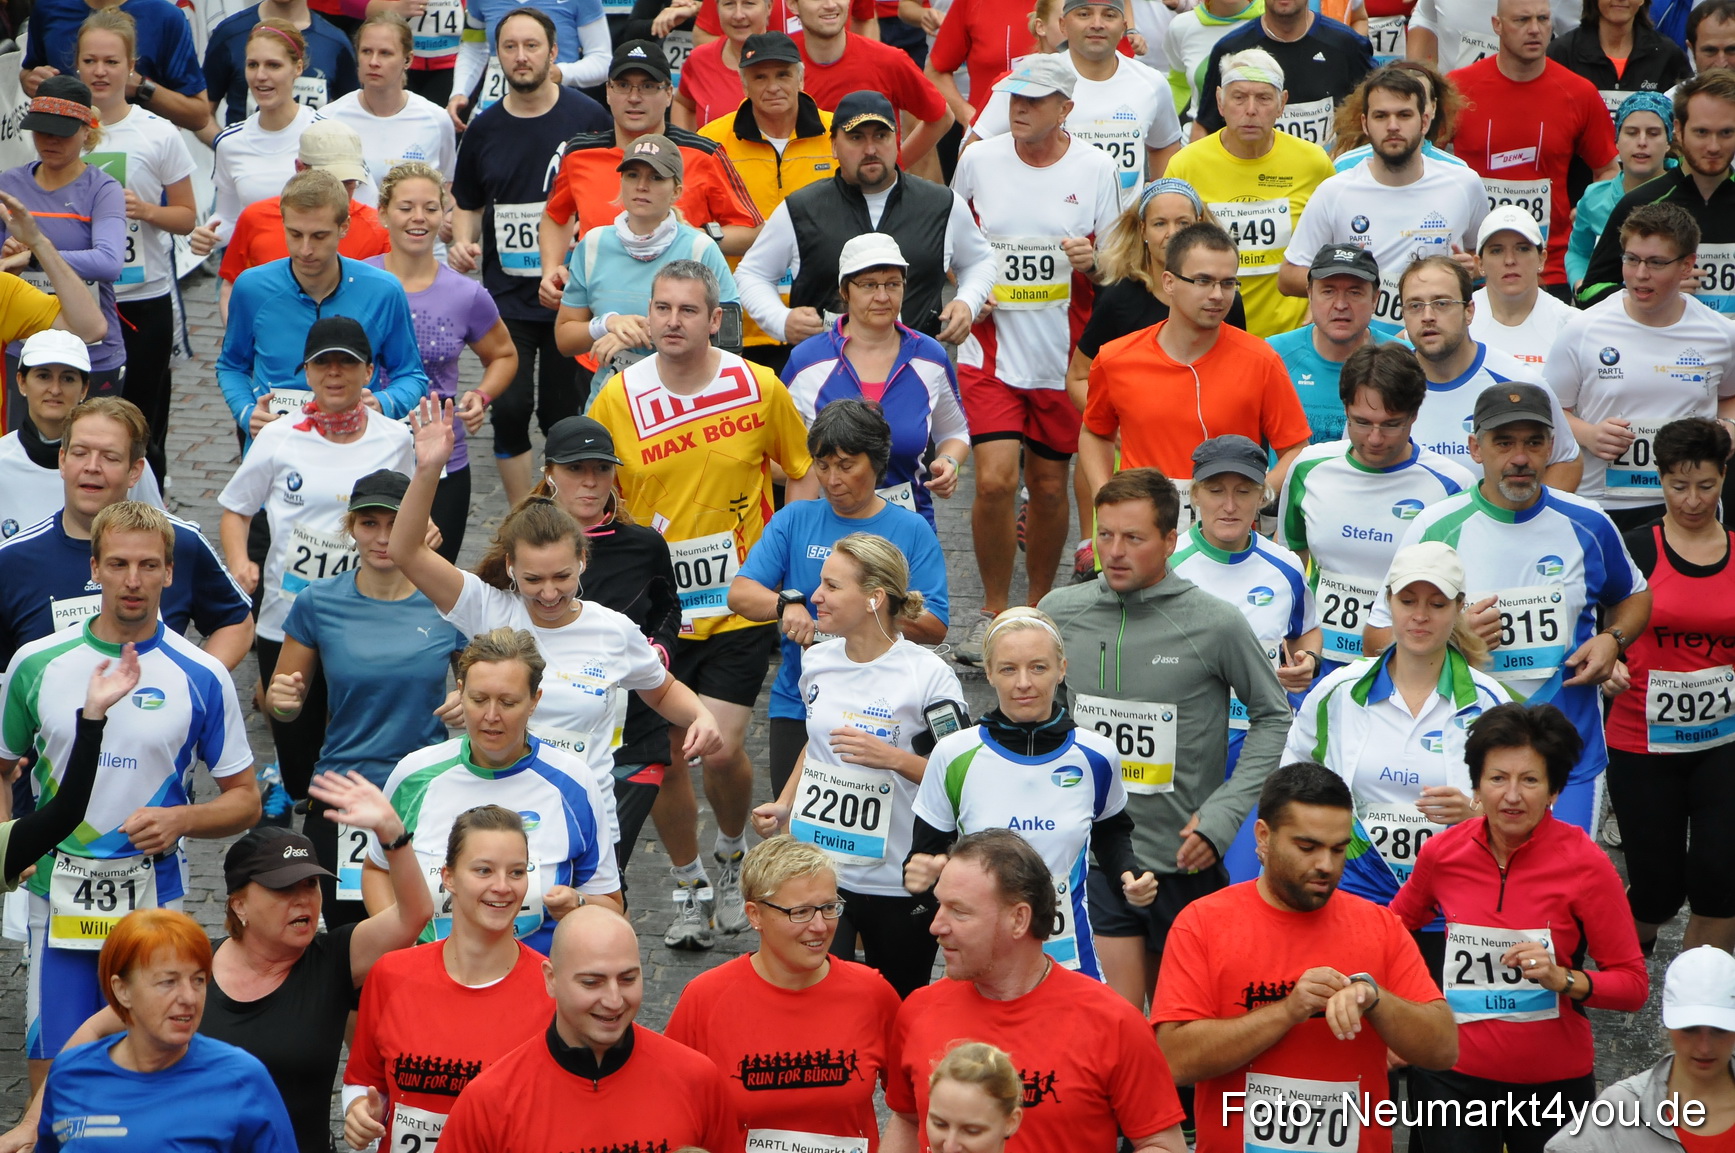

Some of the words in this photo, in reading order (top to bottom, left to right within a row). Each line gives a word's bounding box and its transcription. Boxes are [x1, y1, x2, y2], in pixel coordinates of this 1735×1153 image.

[406, 10, 457, 32] 714
[415, 39, 448, 50] eglinde
[1095, 131, 1130, 139] Neumarkt
[1237, 208, 1275, 216] Neumarkt
[991, 242, 1016, 251] PARTL
[1005, 255, 1055, 282] 359
[1010, 289, 1048, 300] Johann
[271, 397, 298, 406] PARTL
[641, 432, 698, 465] MAX
[702, 412, 766, 444] BÖGL
[293, 528, 320, 546] PARTL
[1342, 525, 1393, 543] Stefan
[675, 543, 720, 558] Neumarkt
[1320, 578, 1348, 591] PARTL
[681, 592, 723, 608] hristian
[1499, 595, 1547, 608] Neumarkt
[56, 606, 90, 618] PARTL
[1503, 653, 1534, 669] Jens
[1650, 678, 1680, 689] PARTL
[1681, 675, 1724, 689] Neumarkt
[1076, 703, 1108, 716] PARTL
[1110, 708, 1157, 721] Neumarkt
[1657, 686, 1732, 723] 2921
[1675, 725, 1719, 743] Regina
[99, 752, 137, 769] illem
[804, 767, 828, 784] PARTL
[830, 774, 875, 793] Neumarkt
[1121, 766, 1144, 780] niel
[1380, 767, 1419, 785] Anja
[801, 784, 881, 832] 2200
[1009, 816, 1055, 830] Anke
[1368, 812, 1397, 823] PARTL
[813, 830, 855, 853] Erwina
[56, 861, 88, 878] PARTL
[90, 865, 139, 879] Neumarkt
[73, 879, 136, 911] 431
[1449, 934, 1477, 946] PARTL
[1485, 994, 1516, 1010] Liba
[398, 1072, 420, 1086] RUN
[423, 1075, 447, 1089] FOR
[747, 1071, 773, 1086] RUN
[778, 1070, 801, 1084] FOR
[804, 1067, 843, 1082] BÜRNI
[1289, 1089, 1343, 1103] Neumarkt
[396, 1113, 429, 1131] PARTL
[749, 1138, 789, 1152] PARTL
